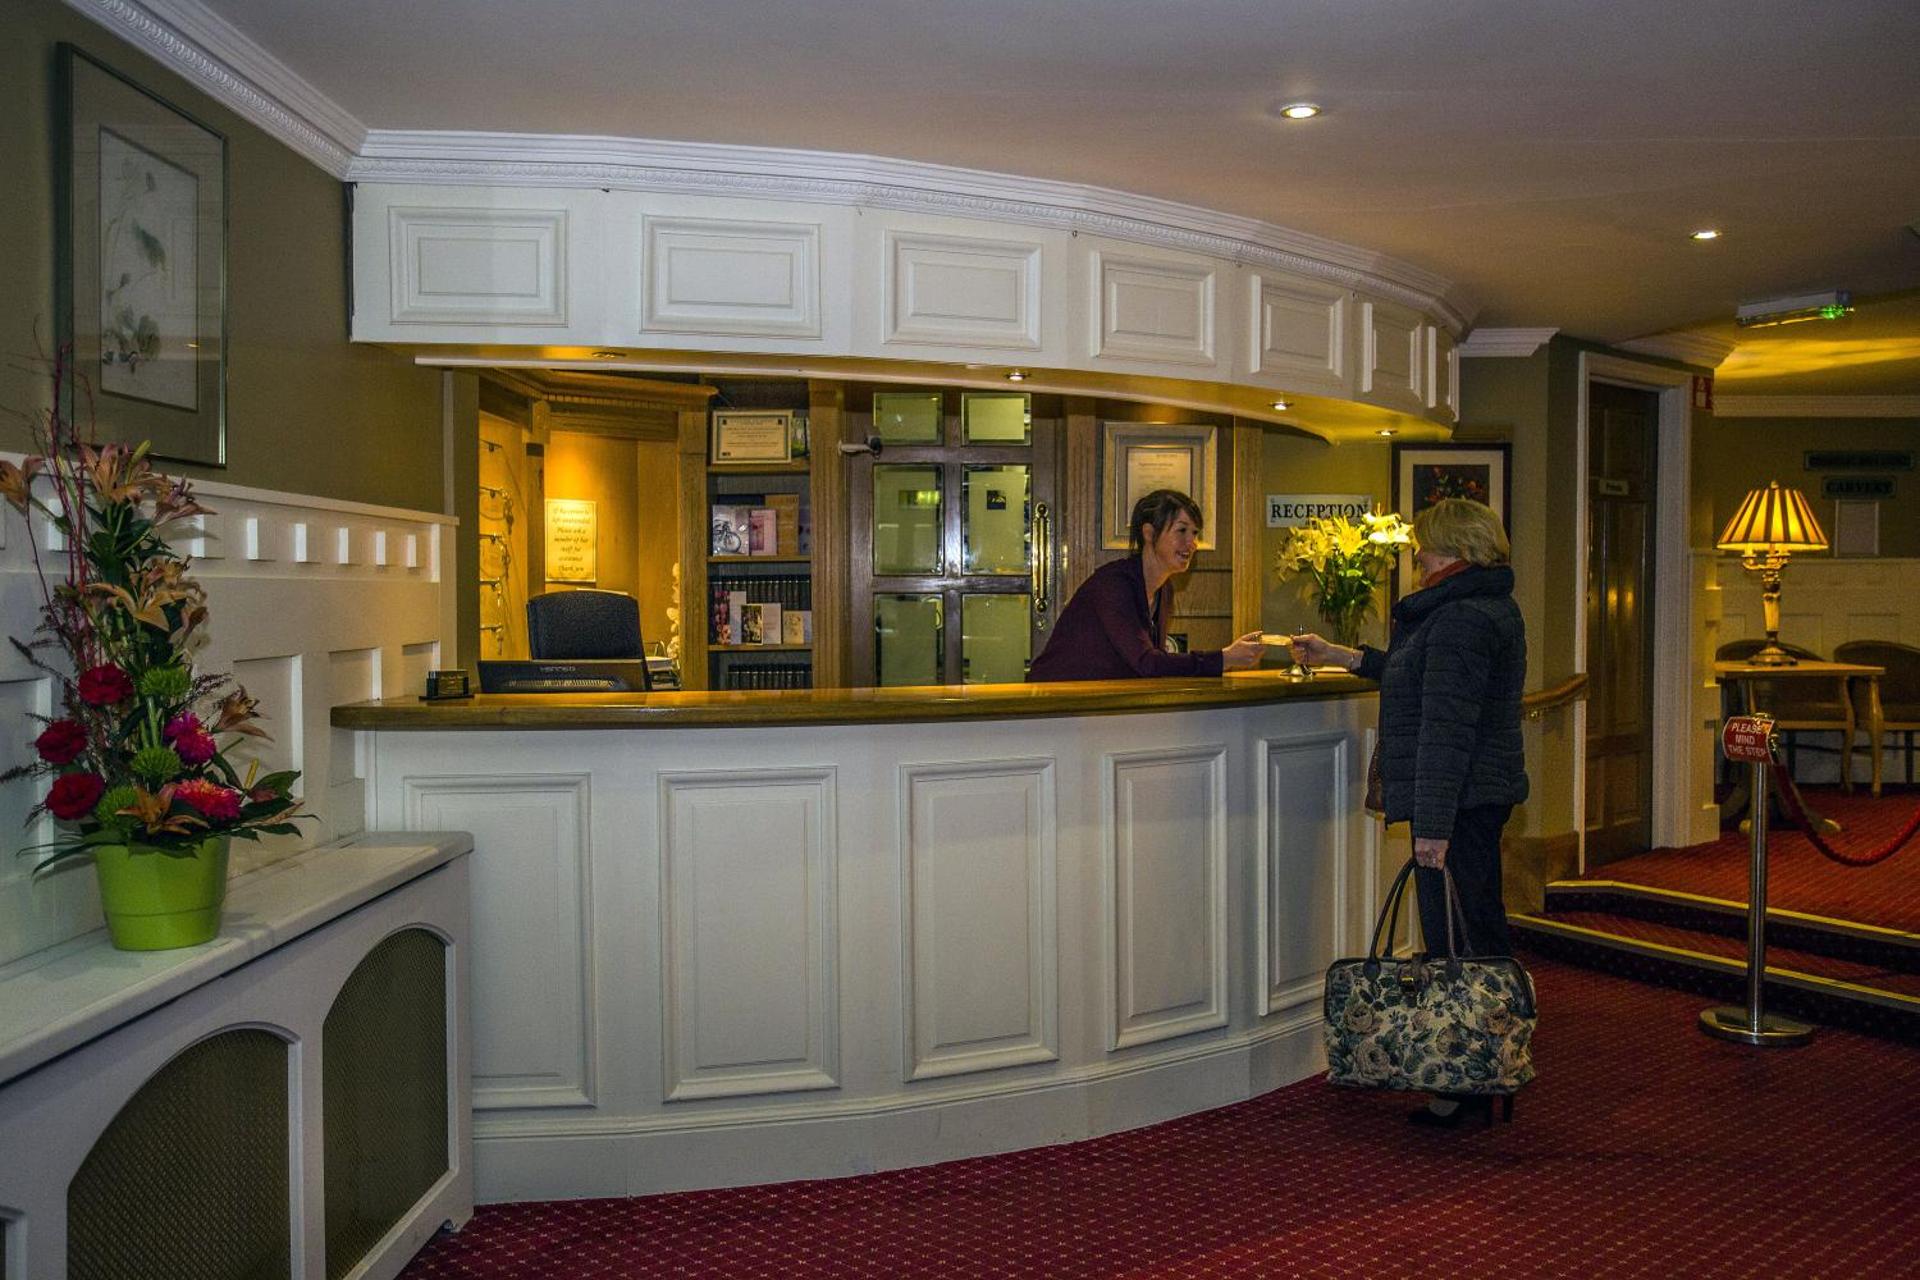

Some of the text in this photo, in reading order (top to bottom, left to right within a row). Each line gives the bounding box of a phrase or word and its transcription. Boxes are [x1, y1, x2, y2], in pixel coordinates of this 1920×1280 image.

[1271, 503, 1368, 519] RECEPTION
[1731, 722, 1762, 735] PLEASE
[1735, 734, 1756, 745] MIND
[1728, 744, 1766, 757] THE STEP
